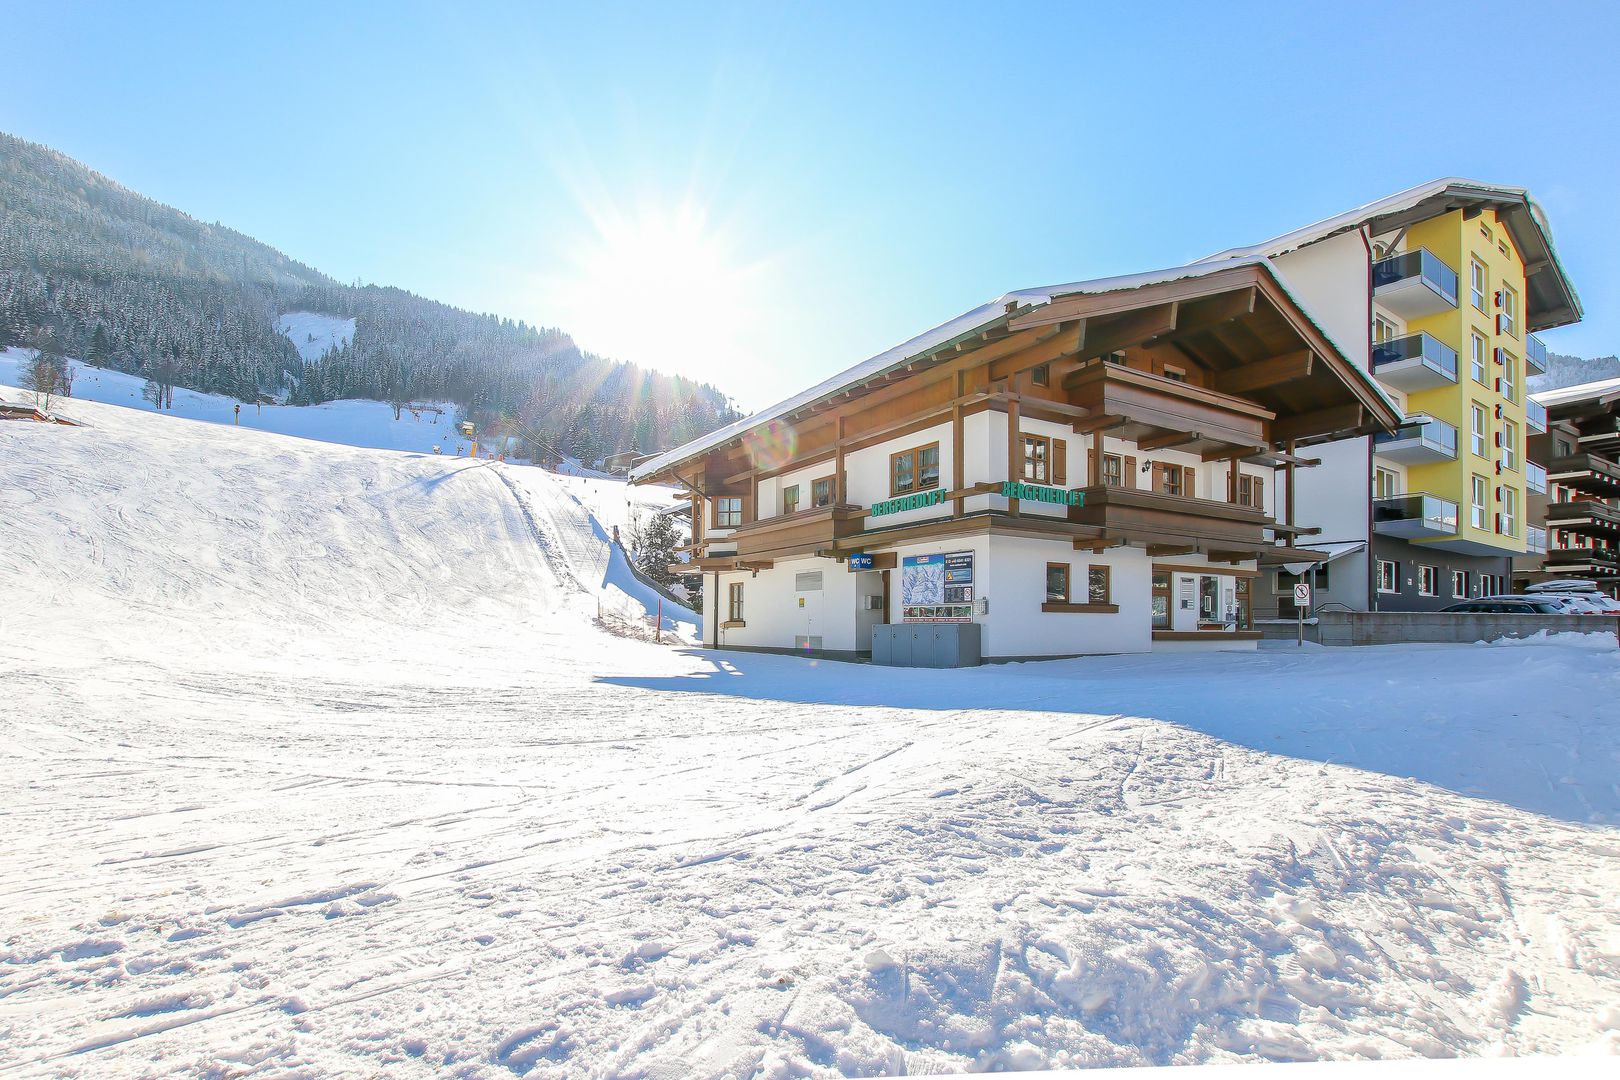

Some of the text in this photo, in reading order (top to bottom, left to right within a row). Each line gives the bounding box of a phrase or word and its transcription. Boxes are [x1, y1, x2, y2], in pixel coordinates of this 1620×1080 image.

[871, 488, 947, 517] BERGFRIEDLIFT
[1001, 481, 1086, 507] BERGFRIEDLIFT
[851, 557, 860, 565] WC
[860, 557, 872, 565] WC
